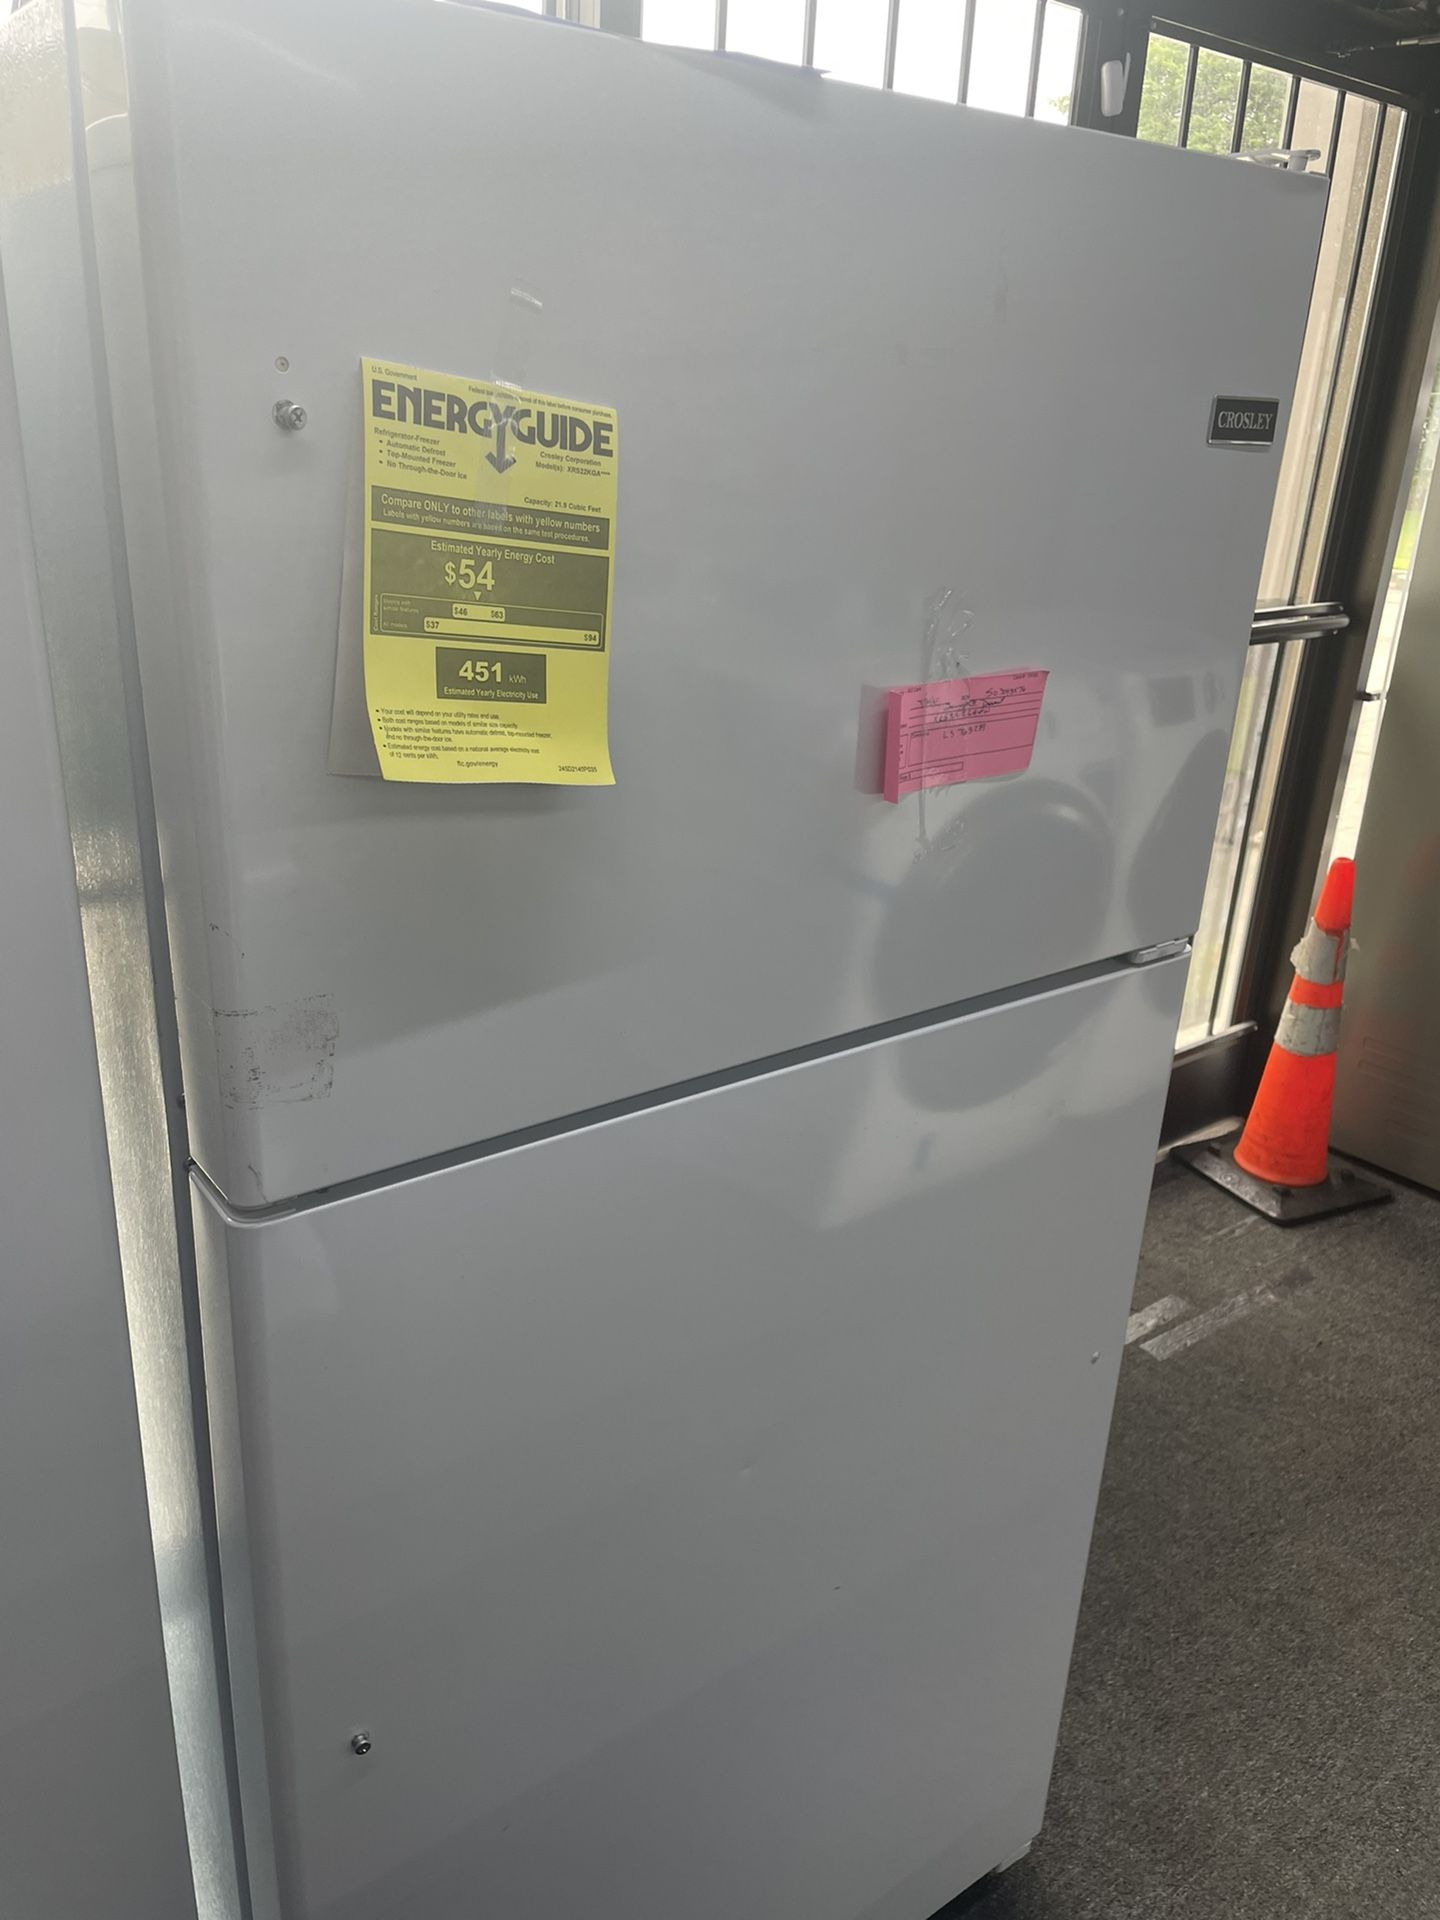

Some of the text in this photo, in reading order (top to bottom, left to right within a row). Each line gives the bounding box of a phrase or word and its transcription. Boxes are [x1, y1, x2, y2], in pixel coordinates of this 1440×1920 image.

[1218, 410, 1273, 430] CROSLEY
[374, 426, 440, 446] Refrigerator-Freezer
[386, 440, 446, 457] Automatic Defrost
[387, 449, 456, 468] Top-Mounted Freezer
[540, 451, 602, 466] Crosley Corporation
[386, 460, 396, 468] No
[398, 462, 456, 478] Through-the-Door
[381, 494, 600, 533] Compare ONLY to other labels with yellow numbers
[524, 496, 553, 508] Capacity:
[568, 502, 586, 512] Cubic
[588, 505, 602, 513] Feet
[383, 508, 405, 519] Labels
[406, 512, 420, 520] with
[420, 514, 442, 524] yellow
[443, 518, 471, 528] numbers
[512, 526, 523, 534] the
[524, 528, 540, 537] same
[541, 530, 553, 538] test
[554, 531, 590, 542] procedures.
[432, 540, 555, 564] Estimated Yearly Energy Cost
[444, 558, 496, 591] $54
[454, 606, 468, 616] $46
[490, 610, 504, 619] $63
[426, 620, 440, 630] $37
[584, 633, 598, 642] $94
[458, 660, 527, 684] 451 kWh
[444, 686, 539, 700] Estimated Yearly Electricity Use
